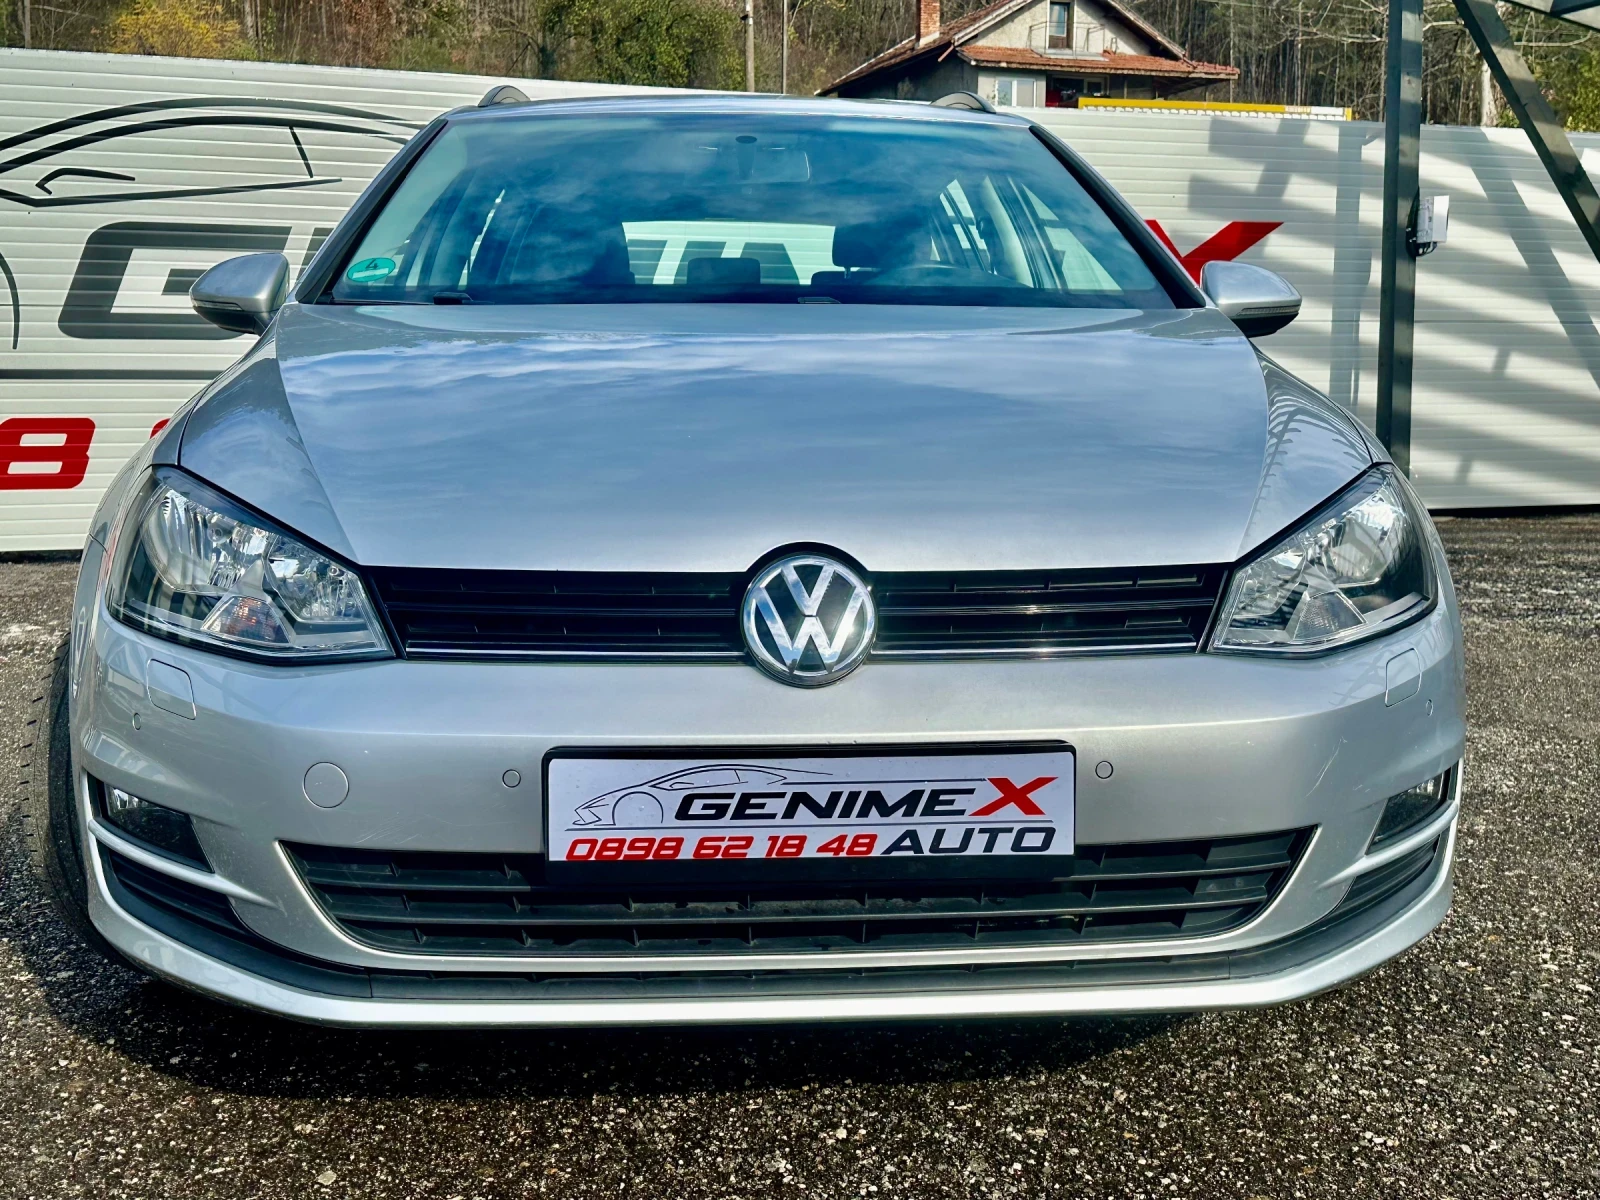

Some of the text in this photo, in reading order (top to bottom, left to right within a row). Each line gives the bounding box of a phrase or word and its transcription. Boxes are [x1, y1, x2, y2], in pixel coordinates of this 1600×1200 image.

[743, 555, 875, 688] VW
[674, 776, 1059, 822] GENIMEX
[565, 826, 1056, 861] 0898 62 18 48 AUTO
